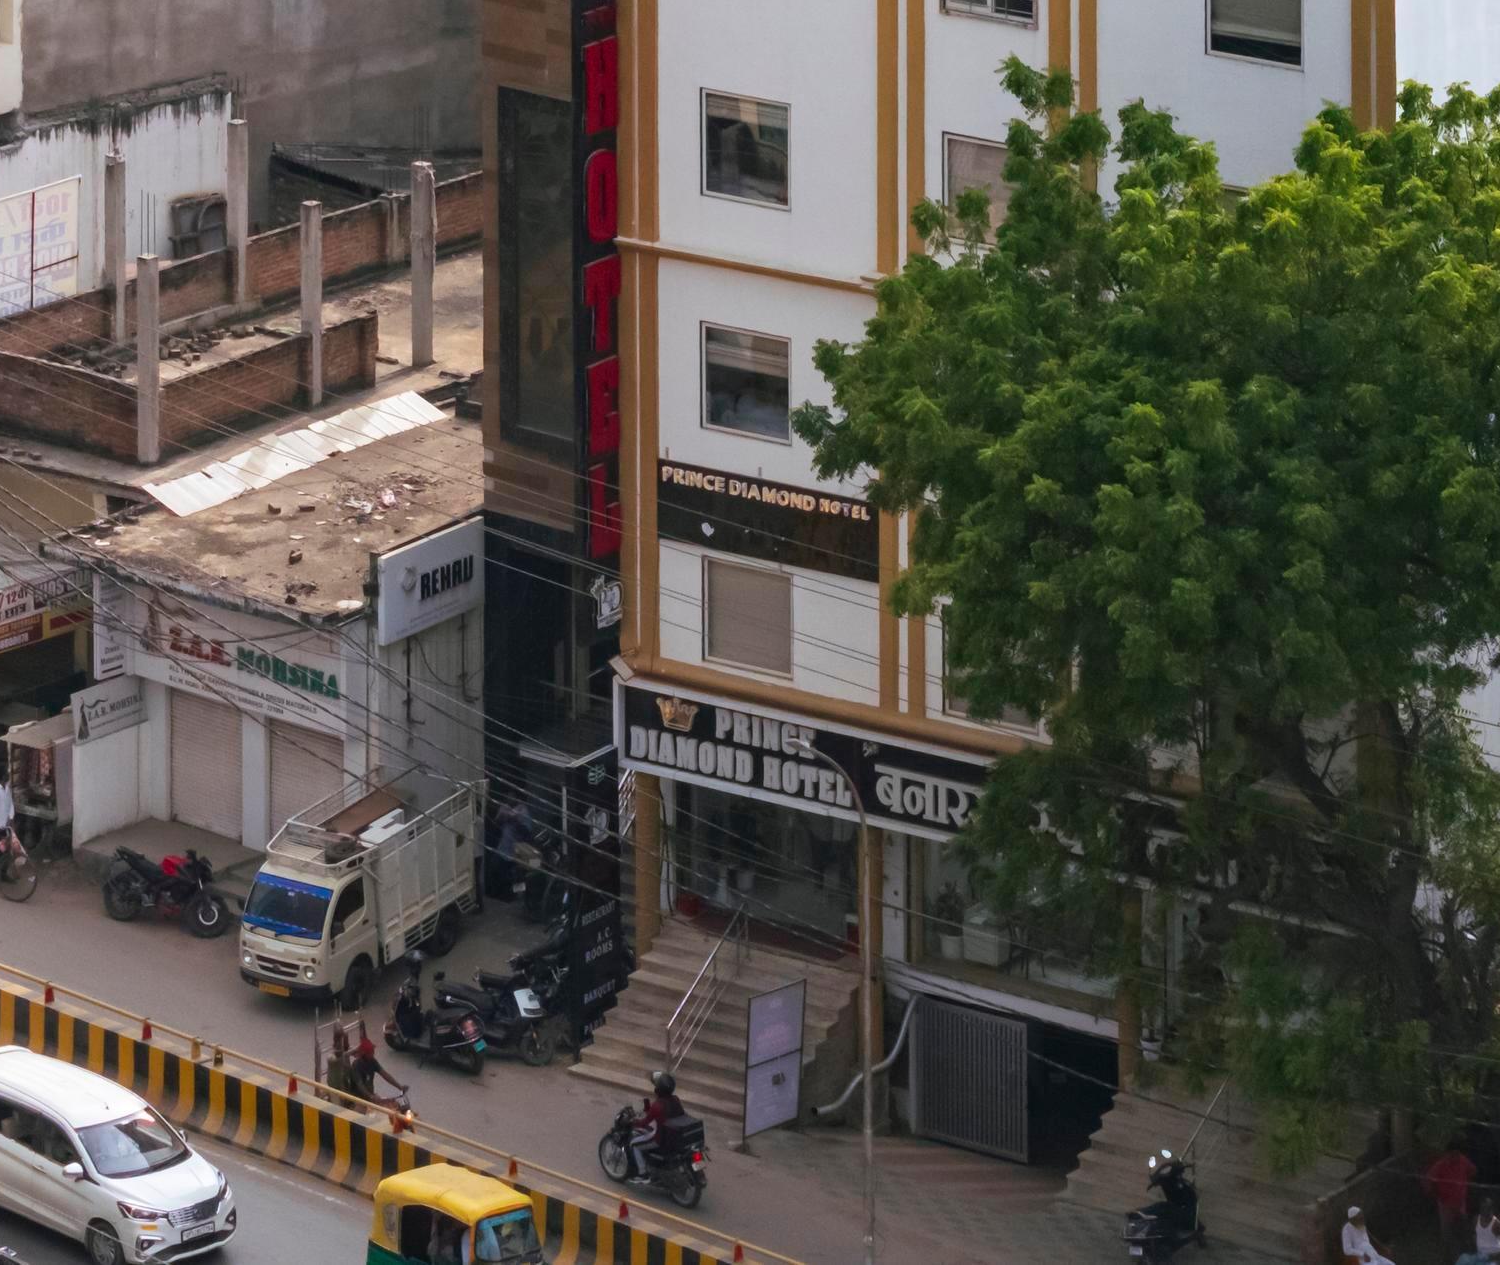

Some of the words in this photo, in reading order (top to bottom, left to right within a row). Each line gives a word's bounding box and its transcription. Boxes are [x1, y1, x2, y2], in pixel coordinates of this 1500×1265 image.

[582, 35, 621, 558] HOTEL
[661, 465, 726, 494] PRINCE
[728, 479, 816, 512] DIAMOND
[819, 497, 871, 522] HOTEL
[420, 554, 474, 601] REHAU
[236, 645, 341, 700] MOHSINA
[714, 707, 816, 760] PRINCE
[630, 724, 754, 783] DIAMOND
[762, 754, 853, 808] HOTEL
[585, 939, 614, 964] ROOMS
